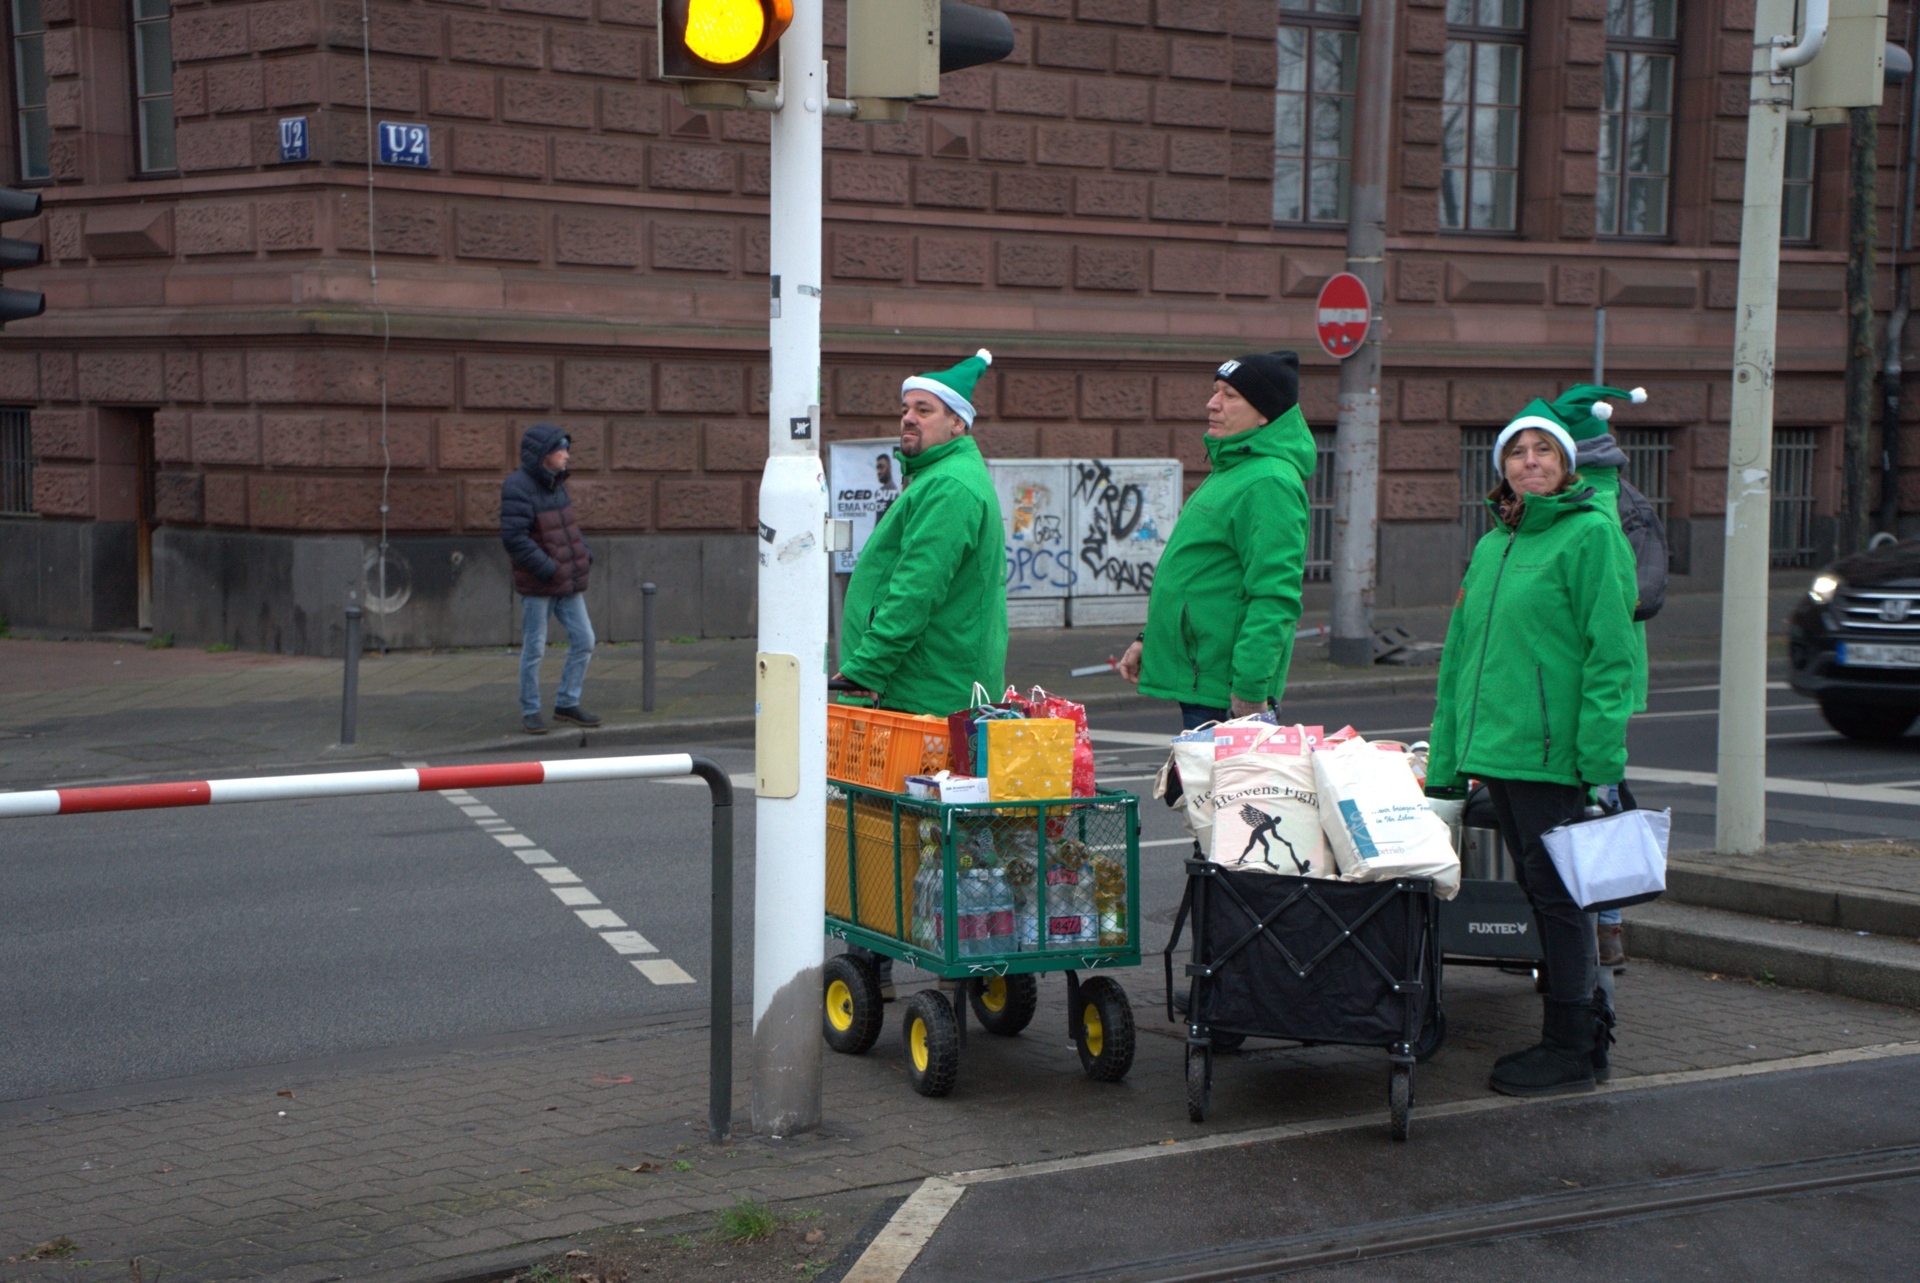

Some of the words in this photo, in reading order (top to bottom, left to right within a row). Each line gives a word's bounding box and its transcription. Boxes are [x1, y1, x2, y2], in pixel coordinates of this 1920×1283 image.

[838, 490, 872, 500] ICED
[875, 489, 899, 501] OUT
[838, 502, 861, 512] EMA
[1468, 922, 1517, 934] FUXTEC
